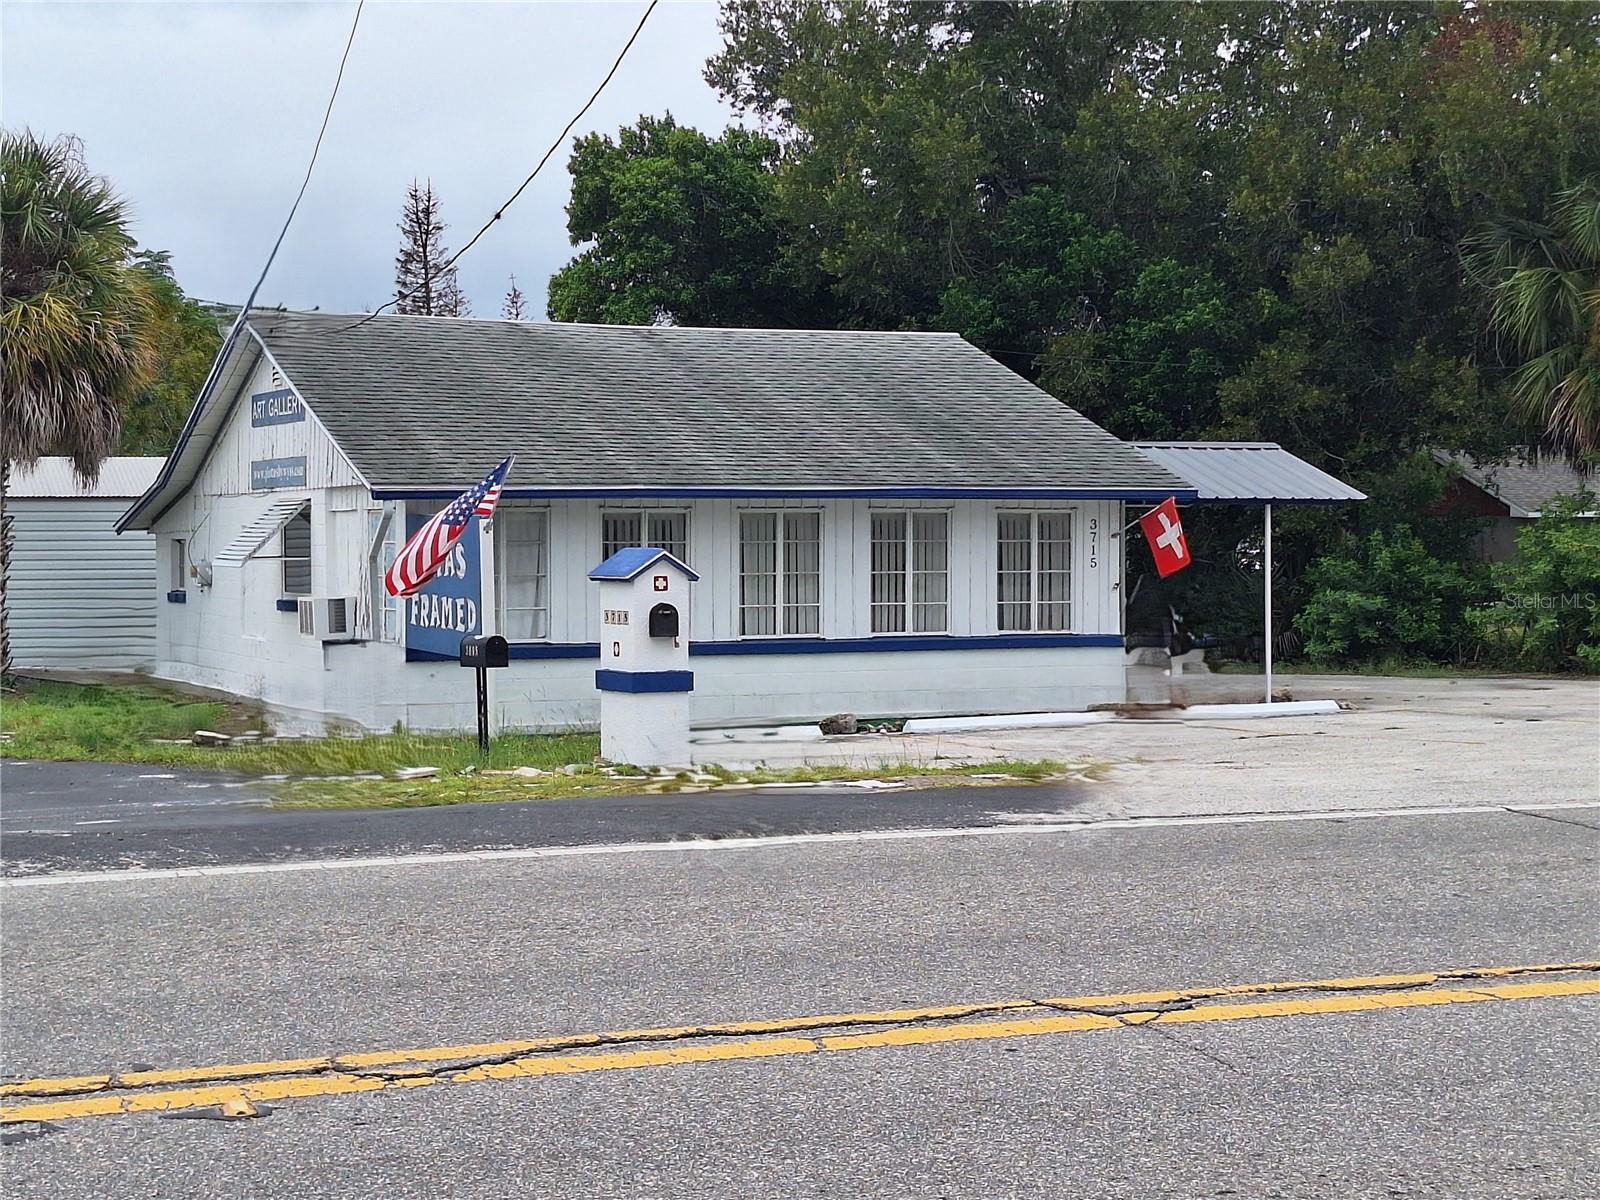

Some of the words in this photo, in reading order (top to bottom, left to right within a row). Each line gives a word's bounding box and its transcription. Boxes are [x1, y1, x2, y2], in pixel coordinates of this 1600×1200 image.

[252, 400, 266, 420] ART
[1089, 518, 1097, 568] 3715
[409, 592, 477, 633] FRAMED
